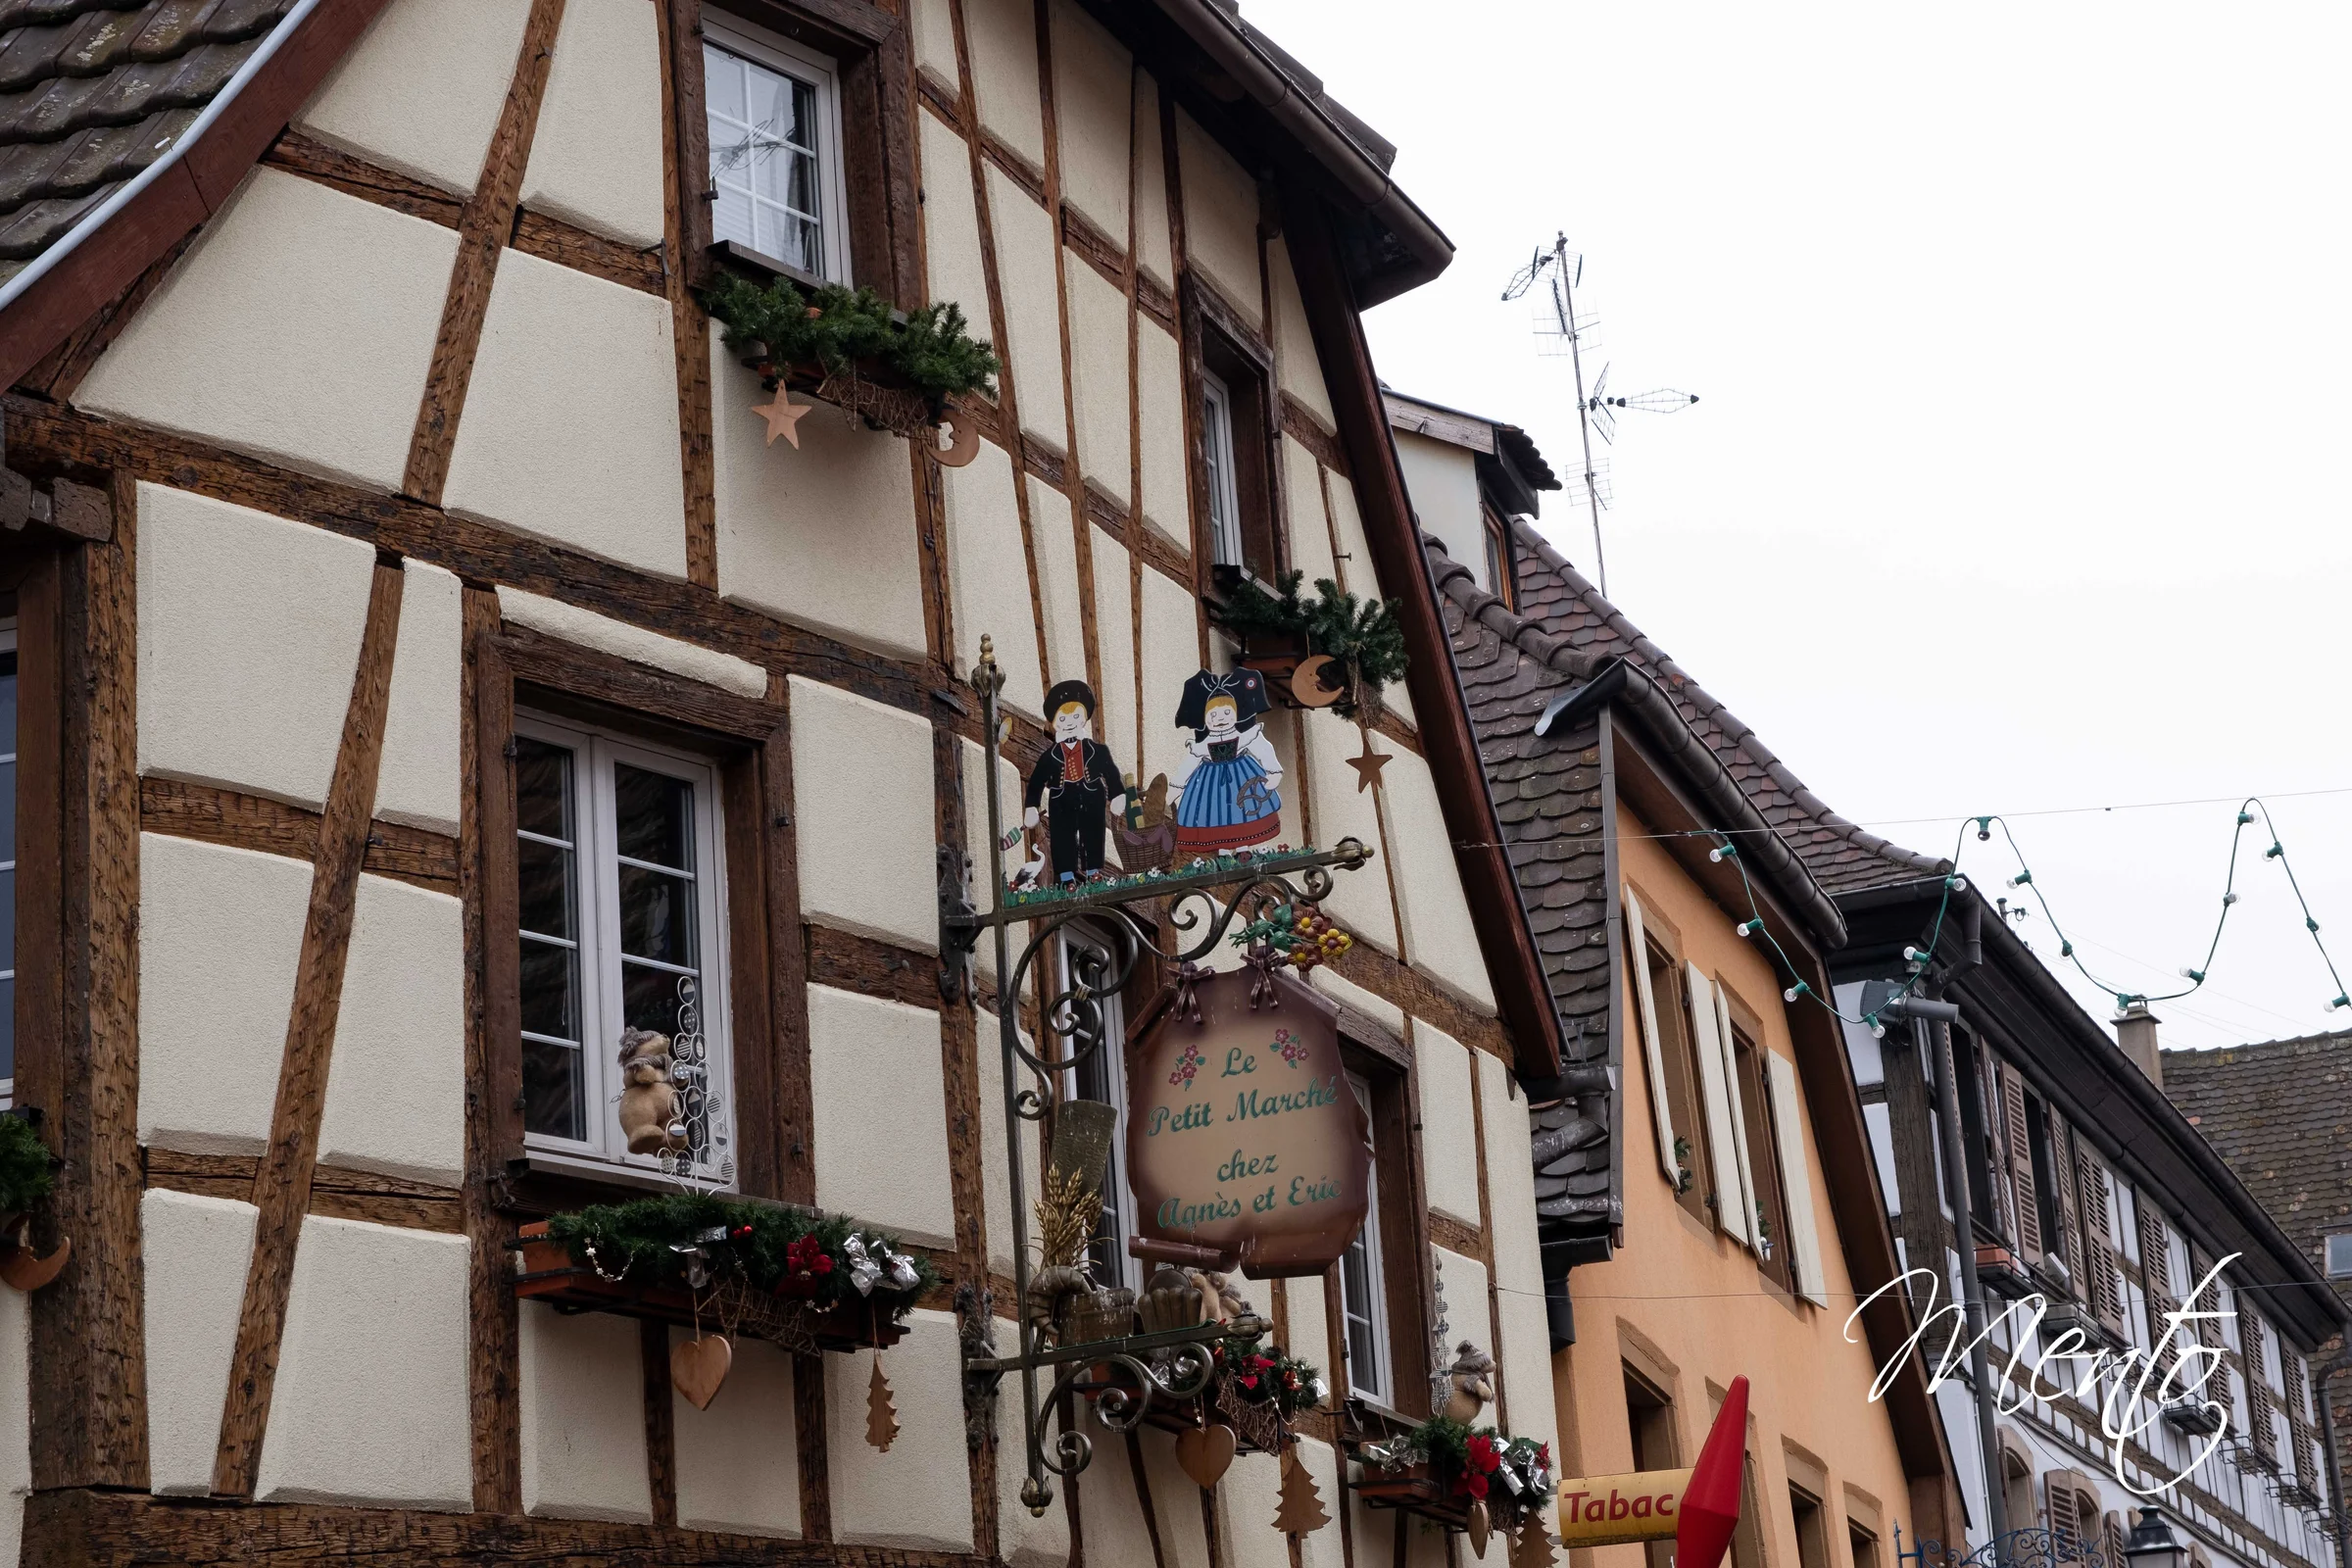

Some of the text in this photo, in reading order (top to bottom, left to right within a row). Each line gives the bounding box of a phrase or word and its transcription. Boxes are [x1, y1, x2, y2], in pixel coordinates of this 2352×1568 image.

[1221, 1047, 1257, 1078] Le
[1146, 1074, 1339, 1137] Petit Marché
[1216, 1149, 1279, 1183] chez
[1157, 1176, 1343, 1232] Agnès et Eric
[1564, 1489, 1674, 1524] Tabac
